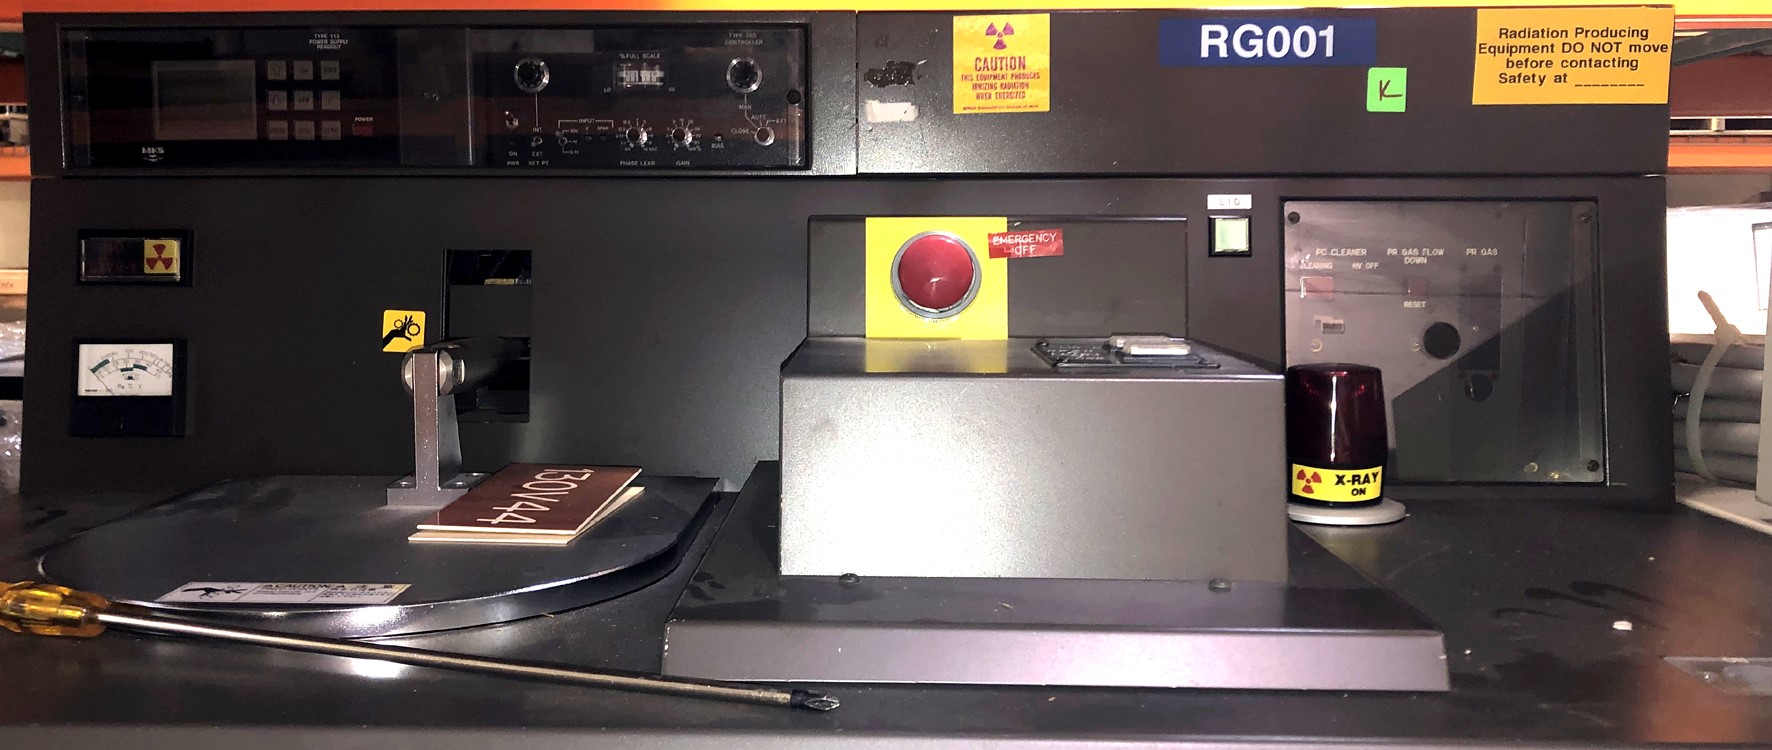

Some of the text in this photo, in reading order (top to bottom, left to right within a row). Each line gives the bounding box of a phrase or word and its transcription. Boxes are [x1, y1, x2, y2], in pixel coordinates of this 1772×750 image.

[1498, 27, 1649, 41] Radiation Producing
[1200, 23, 1335, 58] RG001
[1478, 41, 1669, 56] Equipment DO NOT move
[974, 56, 1026, 72] CAUTION
[1506, 57, 1639, 70] before contacting
[961, 72, 1040, 82] THIS EQUIPMENT PRODUCES
[1498, 72, 1568, 86] Safety at
[1000, 82, 1029, 90] RADIATION
[1379, 79, 1403, 101] K
[976, 91, 1026, 100] WHEN ENERGIZED
[141, 146, 164, 154] MKS
[992, 232, 1057, 246] EMERGENCY
[1014, 245, 1037, 255] OFF
[1331, 247, 1368, 256] CLEANER
[1387, 248, 1445, 256] PR GAS FLOW
[1466, 248, 1498, 256] PR GAS
[1404, 256, 1428, 265] DOWN
[1366, 262, 1380, 270] OFF
[1334, 471, 1380, 486] X-RAY
[1351, 487, 1367, 496] ON
